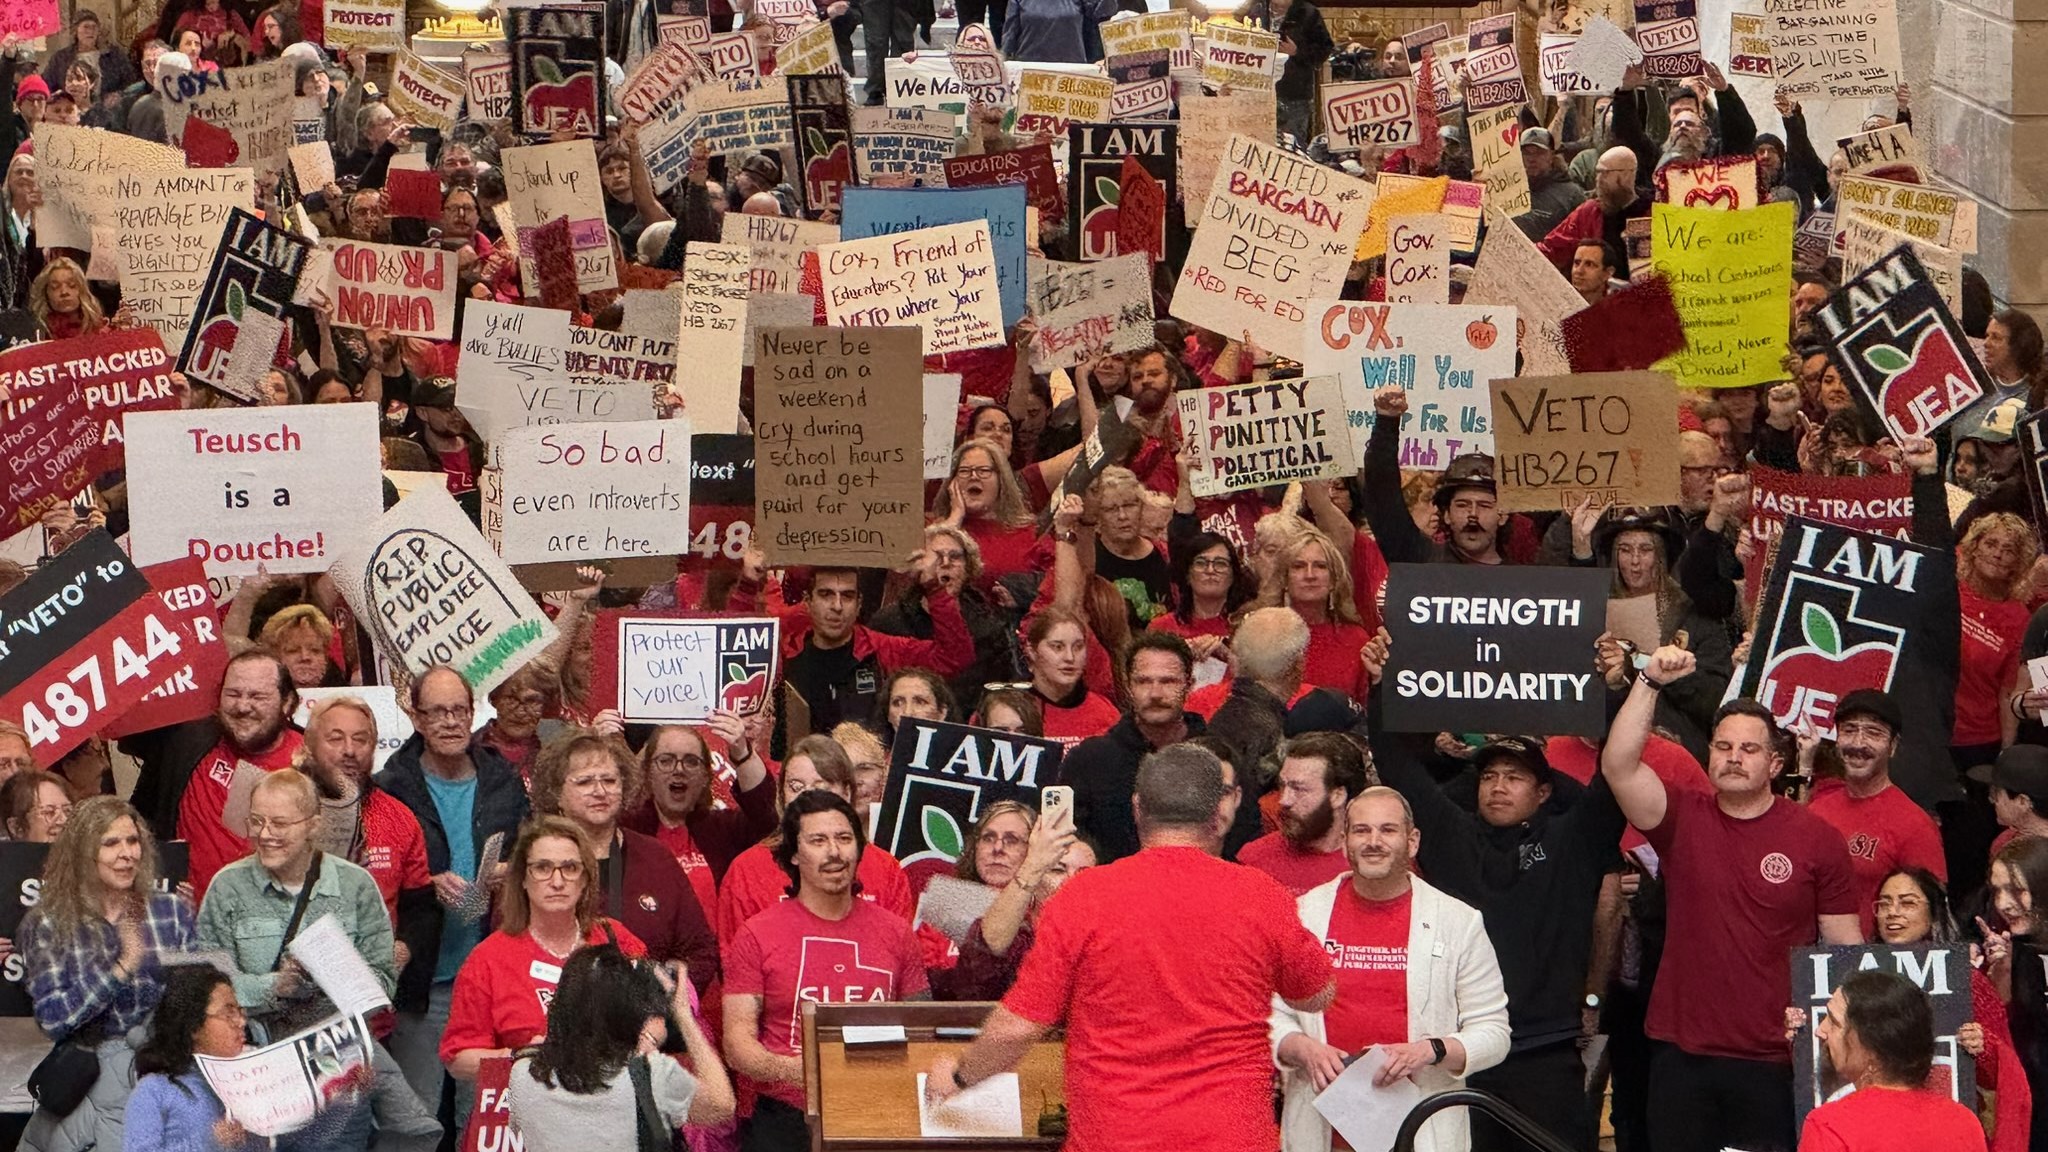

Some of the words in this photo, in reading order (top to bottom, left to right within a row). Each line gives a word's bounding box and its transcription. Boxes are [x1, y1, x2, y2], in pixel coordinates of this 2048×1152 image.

[331, 9, 394, 26] PROTECT
[1776, 13, 1877, 30] BARGAINING
[1643, 25, 1693, 48] VETO
[1771, 34, 1817, 48] SAVES
[1824, 31, 1867, 43] TIME
[1209, 47, 1266, 68] PROTECT
[1470, 52, 1511, 77] VETO
[398, 70, 453, 111] PROTECT
[895, 78, 926, 98] We
[1114, 85, 1164, 109] VETO
[1471, 83, 1521, 105] HB267
[527, 106, 593, 135] UEA
[1335, 92, 1400, 125] VETO
[1081, 127, 1095, 155] I
[1102, 127, 1166, 156] AM
[1347, 121, 1413, 145] HB267
[1229, 137, 1328, 198] UNITED
[1480, 145, 1511, 174] ALL
[119, 174, 141, 199] NO
[154, 174, 236, 197] AMOUNT
[559, 170, 579, 193] up
[1694, 166, 1730, 186] WE
[1229, 171, 1343, 232] BARGAIN
[1843, 180, 1890, 206] DON'T
[1892, 189, 1957, 216] SILENCE
[120, 203, 196, 230] REVENGE
[1211, 196, 1310, 250] DIVIDED
[171, 233, 207, 251] YOU
[1394, 225, 1434, 253] Gov.
[1663, 214, 1711, 250] We
[830, 250, 879, 275] Cox,
[893, 236, 957, 267] Friend
[965, 230, 986, 254] of
[1223, 234, 1300, 283] BEG
[1390, 258, 1438, 286] Cox:
[337, 286, 435, 331] UNION
[1235, 285, 1267, 313] FOR
[1274, 299, 1304, 323] ED
[1817, 302, 1850, 338] I
[1848, 258, 1920, 322] AM
[568, 327, 597, 346] YOU
[763, 332, 828, 356] Never
[841, 331, 870, 355] be
[774, 360, 814, 381] sad
[825, 366, 848, 379] on
[858, 364, 872, 379] a
[1435, 354, 1474, 390] You
[517, 384, 617, 416] VETO
[778, 387, 868, 407] weekend
[1208, 381, 1309, 421] PETTY
[1500, 388, 1631, 436] VETO
[1889, 372, 1975, 439] UEA
[187, 424, 303, 454] Teusch
[803, 415, 864, 445] during
[1209, 409, 1326, 450] PUNITIVE
[538, 434, 586, 466] So
[601, 429, 672, 466] bad.
[770, 445, 836, 467] school
[849, 447, 904, 466] hours
[1212, 442, 1333, 480] POLITICAL
[691, 461, 735, 481] text
[785, 468, 826, 487] and
[837, 467, 880, 495] get
[224, 482, 250, 509] is
[273, 487, 291, 507] a
[512, 491, 575, 516] even
[589, 484, 682, 512] introverts
[762, 497, 804, 516] paid
[816, 496, 847, 515] for
[863, 499, 911, 519] your
[1752, 486, 1914, 519] FAST-TRACKE
[188, 531, 324, 563] Douche!
[548, 531, 588, 554] are
[604, 527, 661, 555] here.
[776, 521, 896, 551] depression.
[96, 559, 124, 584] to
[1792, 525, 1824, 568] I
[1823, 536, 1927, 593] AM
[382, 550, 464, 629] PUBLIC
[395, 569, 484, 654] EMPLOYEE
[1407, 596, 1581, 627] STRENGTH
[418, 608, 493, 669] VOICE
[720, 629, 727, 651] I
[733, 627, 769, 650] AM
[1476, 637, 1501, 663] in
[22, 613, 181, 748] 48744
[646, 657, 689, 679] our
[1397, 669, 1592, 702] SOLIDARITY
[908, 725, 938, 770] I
[941, 733, 1046, 788] AM
[1809, 953, 1834, 999] I
